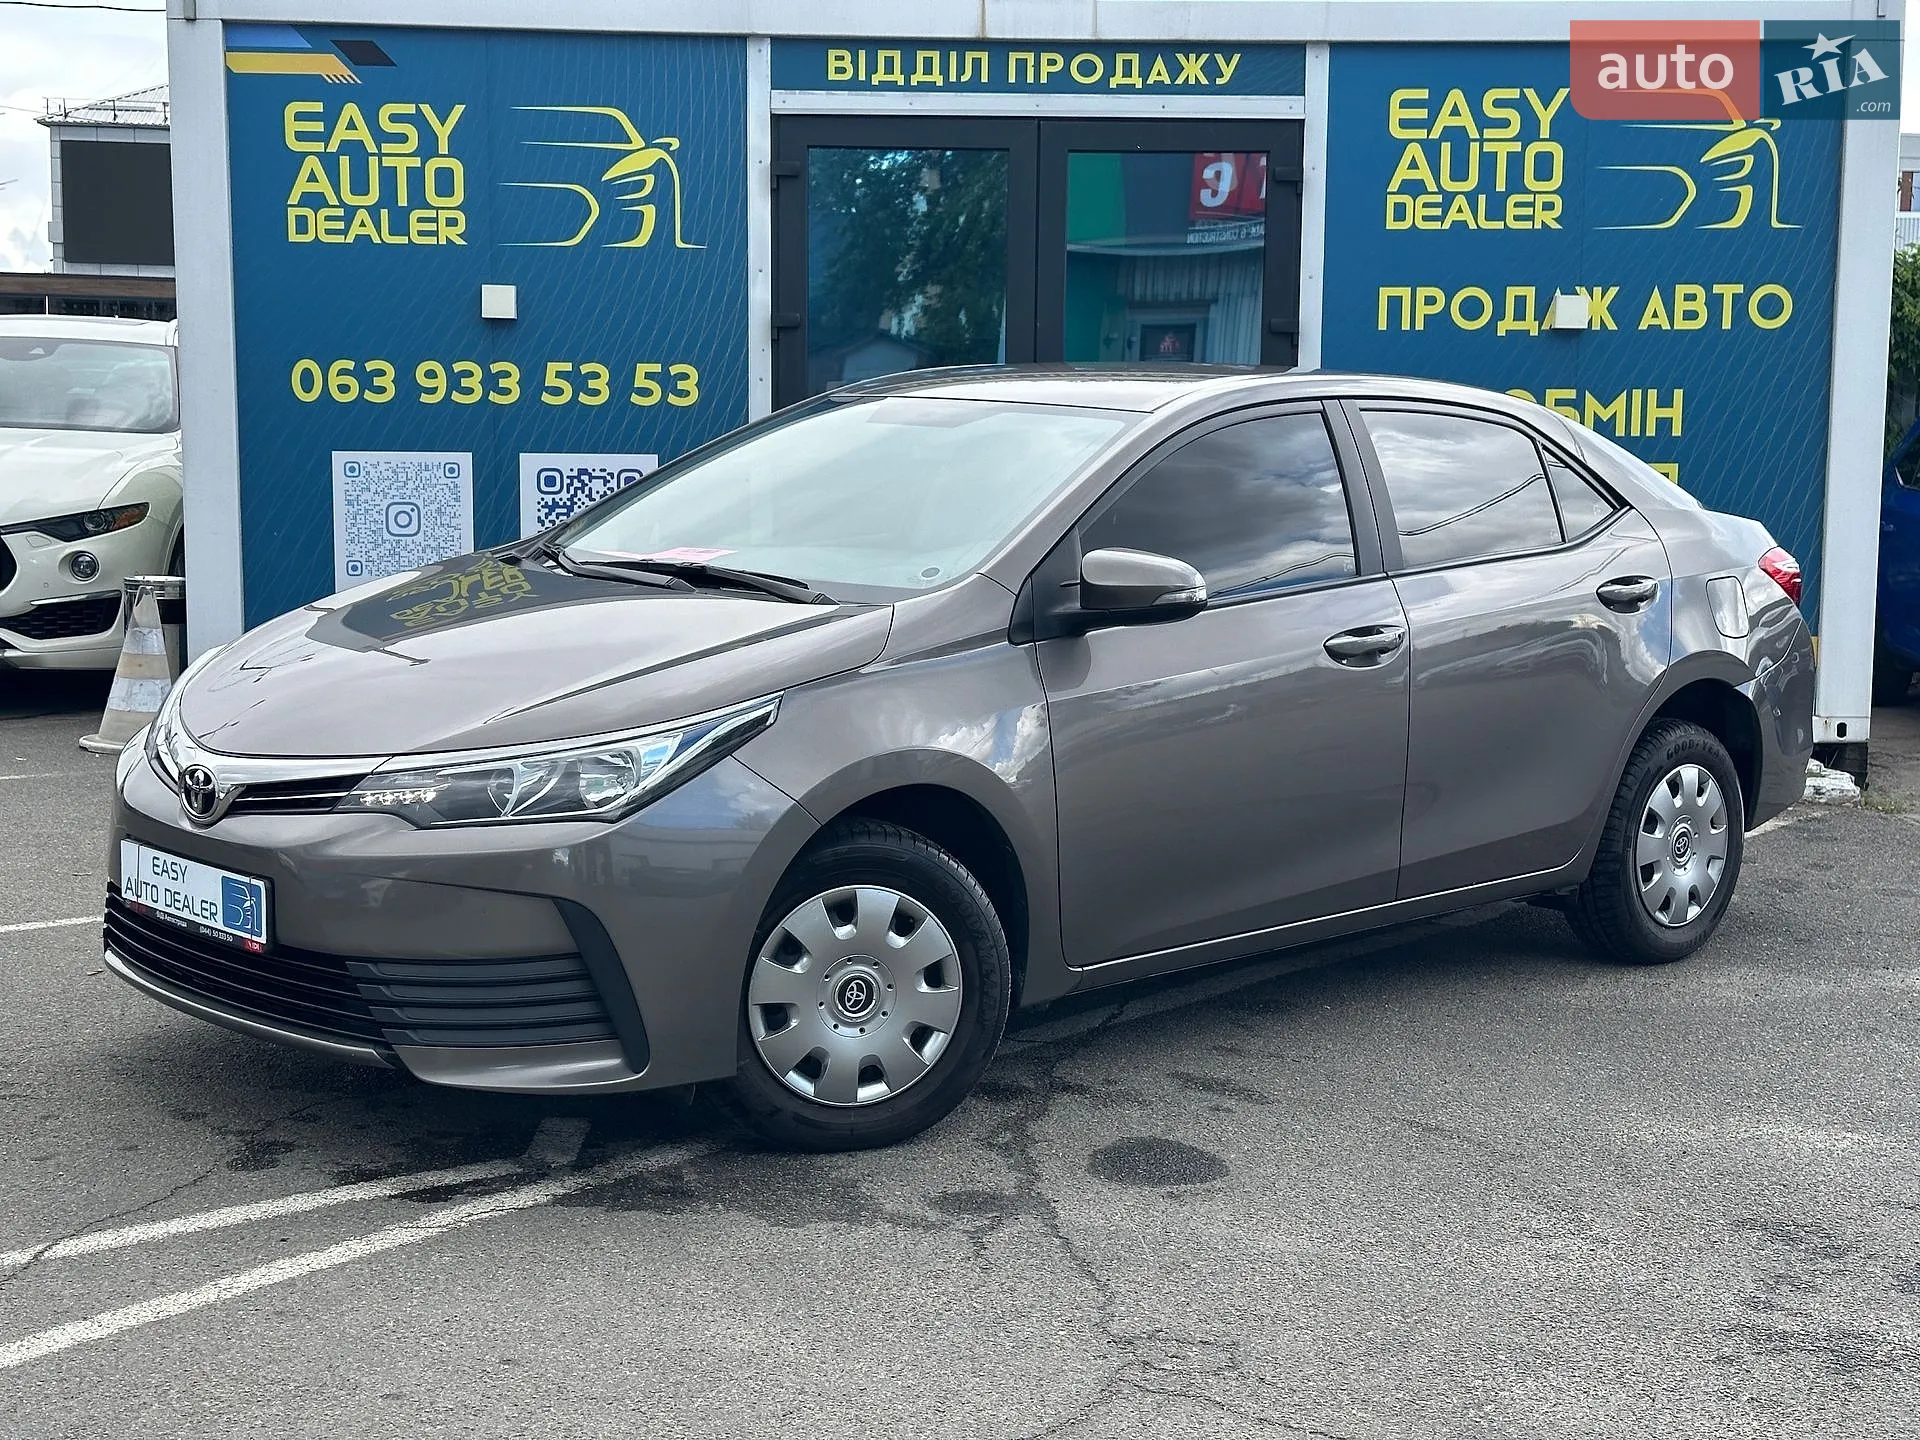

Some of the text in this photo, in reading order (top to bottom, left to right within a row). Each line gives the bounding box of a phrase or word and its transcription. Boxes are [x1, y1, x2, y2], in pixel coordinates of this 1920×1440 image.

[826, 48, 1243, 89] ВІДДІЛ ПРОДАЖУ
[283, 101, 467, 154] EASY
[1387, 87, 1570, 140] EASY
[286, 155, 466, 208] AUTO
[1387, 141, 1564, 192] AUTO
[287, 208, 468, 246] DEALER
[1385, 194, 1563, 231] DEALER
[1639, 284, 1794, 330] АВТО
[290, 358, 700, 407] 063 933 53 53
[1503, 388, 1685, 437] БМІН
[151, 855, 188, 883] EASY
[124, 876, 160, 904] AUTO
[164, 887, 219, 923] DEALER
